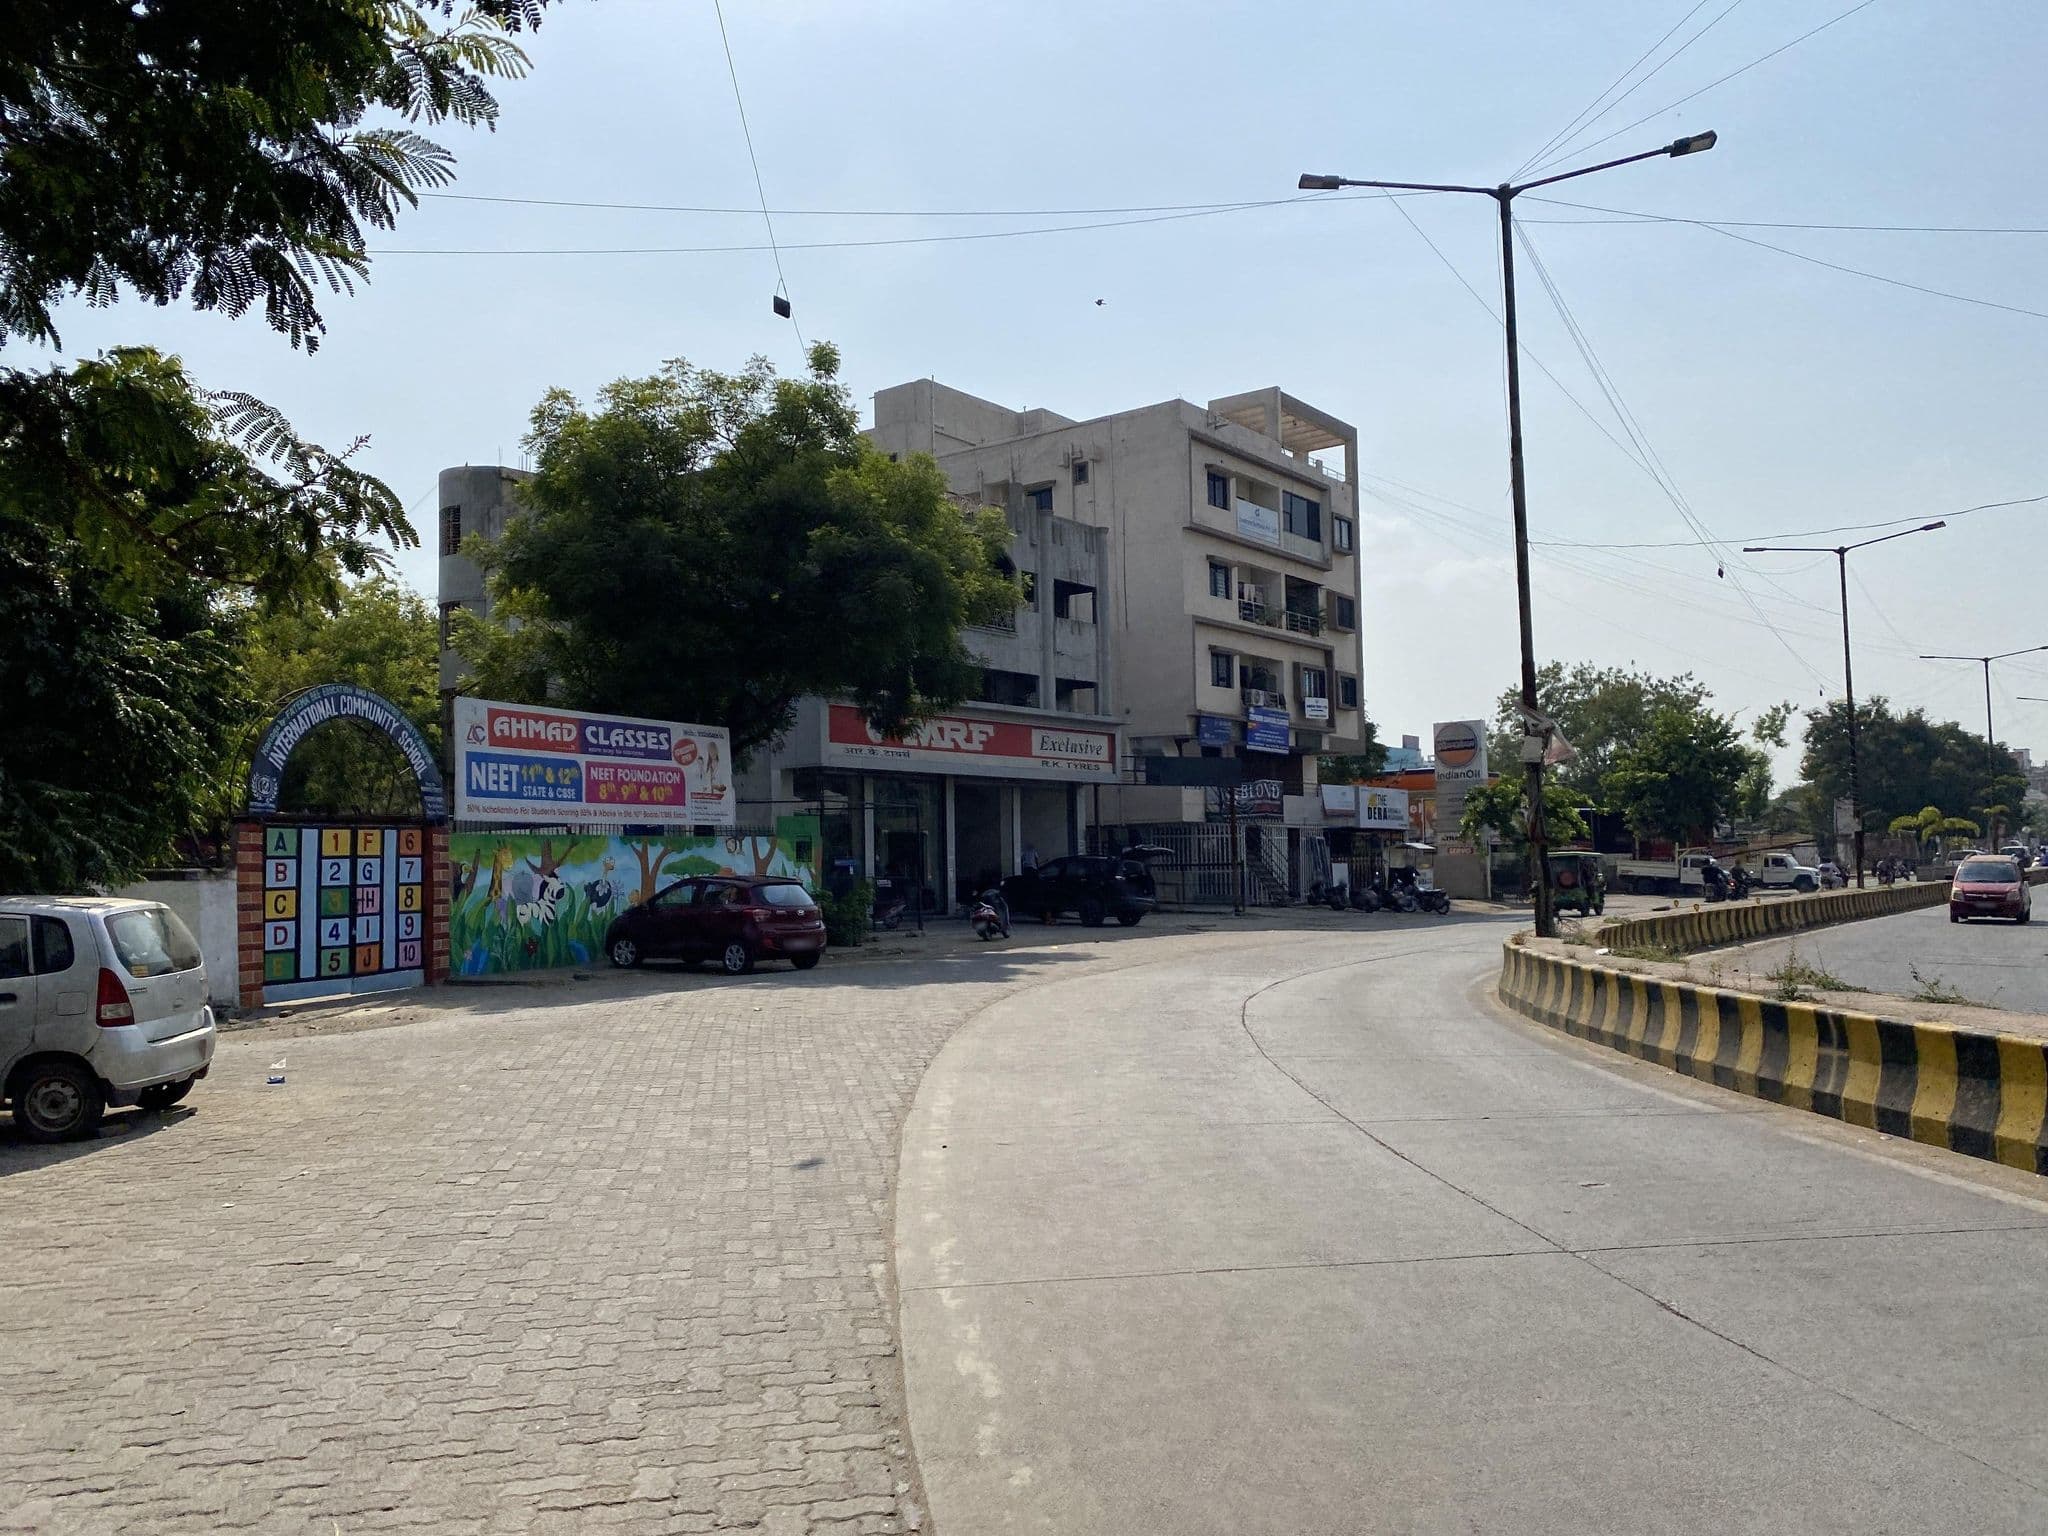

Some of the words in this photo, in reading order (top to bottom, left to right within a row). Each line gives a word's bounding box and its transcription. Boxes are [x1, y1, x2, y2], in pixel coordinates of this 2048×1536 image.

[268, 697, 339, 771] INTERNATIONAL
[340, 695, 398, 734] COMMUNITY
[398, 731, 428, 780] SCHOOL
[493, 716, 577, 742] AHMAD
[585, 725, 670, 751] CLASSES
[903, 717, 994, 751] MRF
[1040, 734, 1103, 756] Exclusive
[545, 766, 555, 784] &
[590, 766, 615, 781] NEET
[617, 768, 681, 784] FOUNDATION
[1066, 761, 1101, 771] TYRES
[471, 761, 520, 792] NEET
[522, 785, 546, 798] STATE
[548, 787, 556, 799] &
[556, 787, 577, 799] CBSE
[639, 784, 649, 801] &
[274, 832, 287, 851] A
[332, 833, 339, 851] 1
[364, 833, 374, 851] F
[405, 833, 415, 850] 6
[275, 862, 288, 882] B
[329, 862, 341, 881] 2
[362, 862, 373, 881] G
[405, 861, 415, 879] 7
[274, 894, 286, 914] C
[328, 892, 341, 912] 3
[365, 890, 375, 909] H
[404, 887, 414, 908] 8
[273, 926, 288, 945] D
[328, 923, 340, 941] 4
[404, 916, 414, 936] 9
[328, 952, 341, 972] 5
[363, 948, 371, 967] J
[403, 944, 416, 962] 10
[272, 957, 285, 976] E
